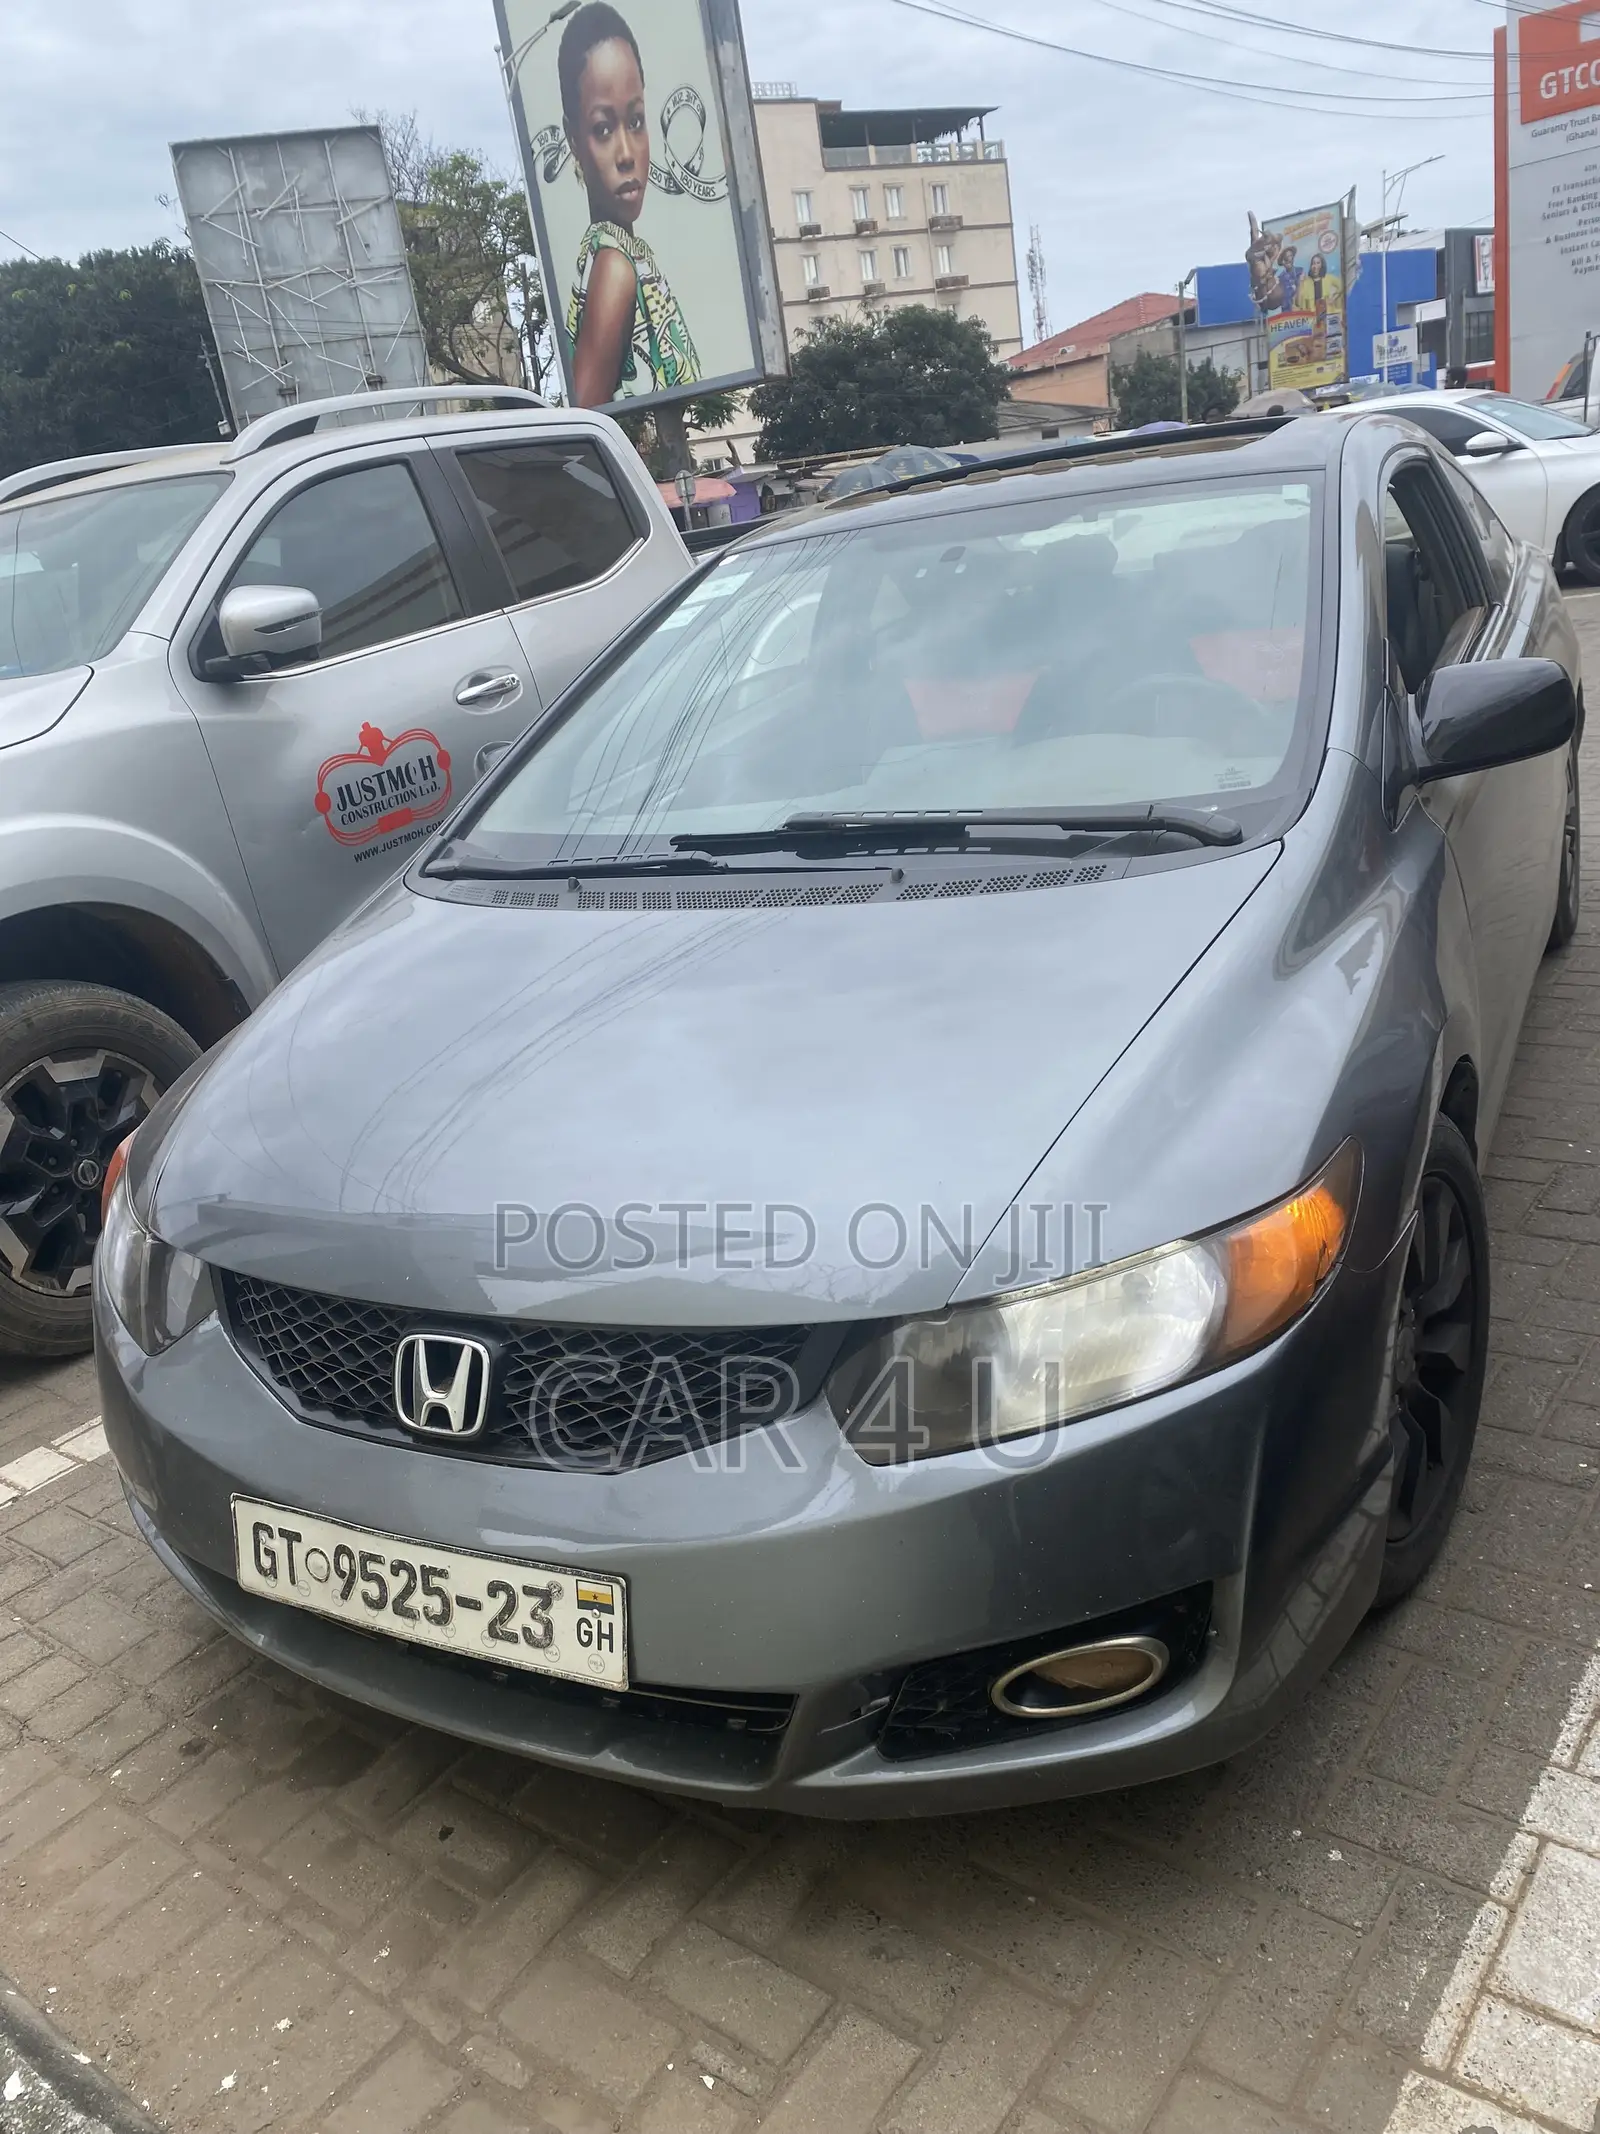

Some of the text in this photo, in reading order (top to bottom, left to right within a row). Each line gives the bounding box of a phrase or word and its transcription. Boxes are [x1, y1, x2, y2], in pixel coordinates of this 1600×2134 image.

[1531, 122, 1569, 138] Guaranty
[1569, 116, 1590, 128] Trust
[1565, 127, 1598, 143] (Ghana)
[649, 166, 662, 183] 180
[679, 171, 716, 197] 180 YEARS
[1578, 216, 1600, 227] Perso
[336, 755, 437, 812] JUSTMOH
[341, 789, 418, 826] CONSTRUCTION
[252, 1521, 555, 1649] GT 9525-23
[576, 1616, 614, 1654] GH
